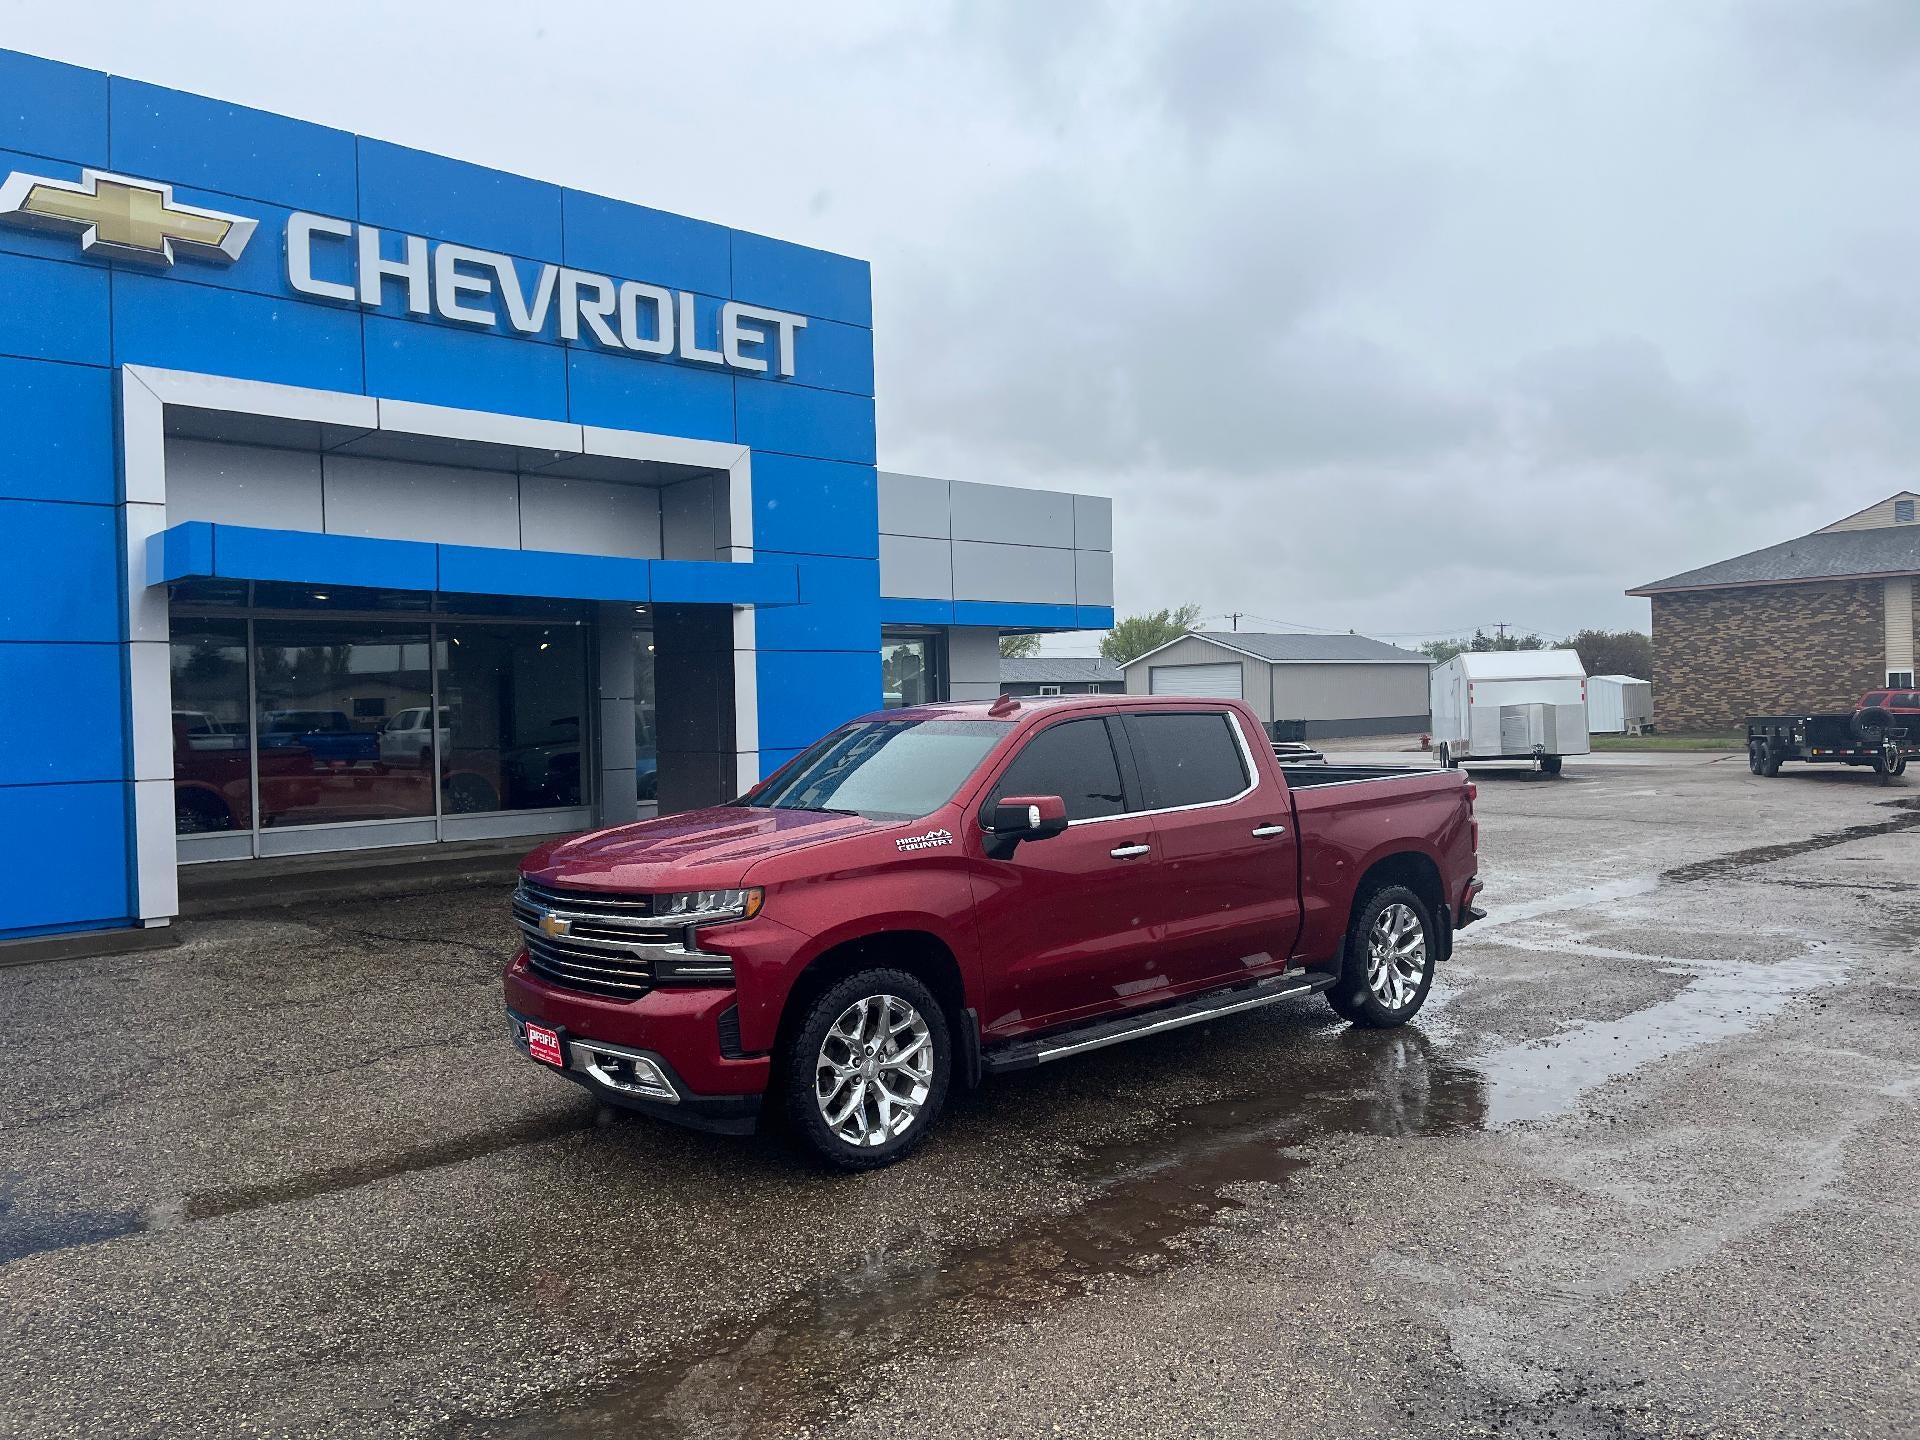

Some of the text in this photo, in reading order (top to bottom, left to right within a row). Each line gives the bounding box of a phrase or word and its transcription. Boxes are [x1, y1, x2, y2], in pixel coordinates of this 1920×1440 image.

[285, 211, 808, 377] CHEVROLET
[896, 836, 926, 846] HIGH
[897, 839, 953, 851] COUNTRY
